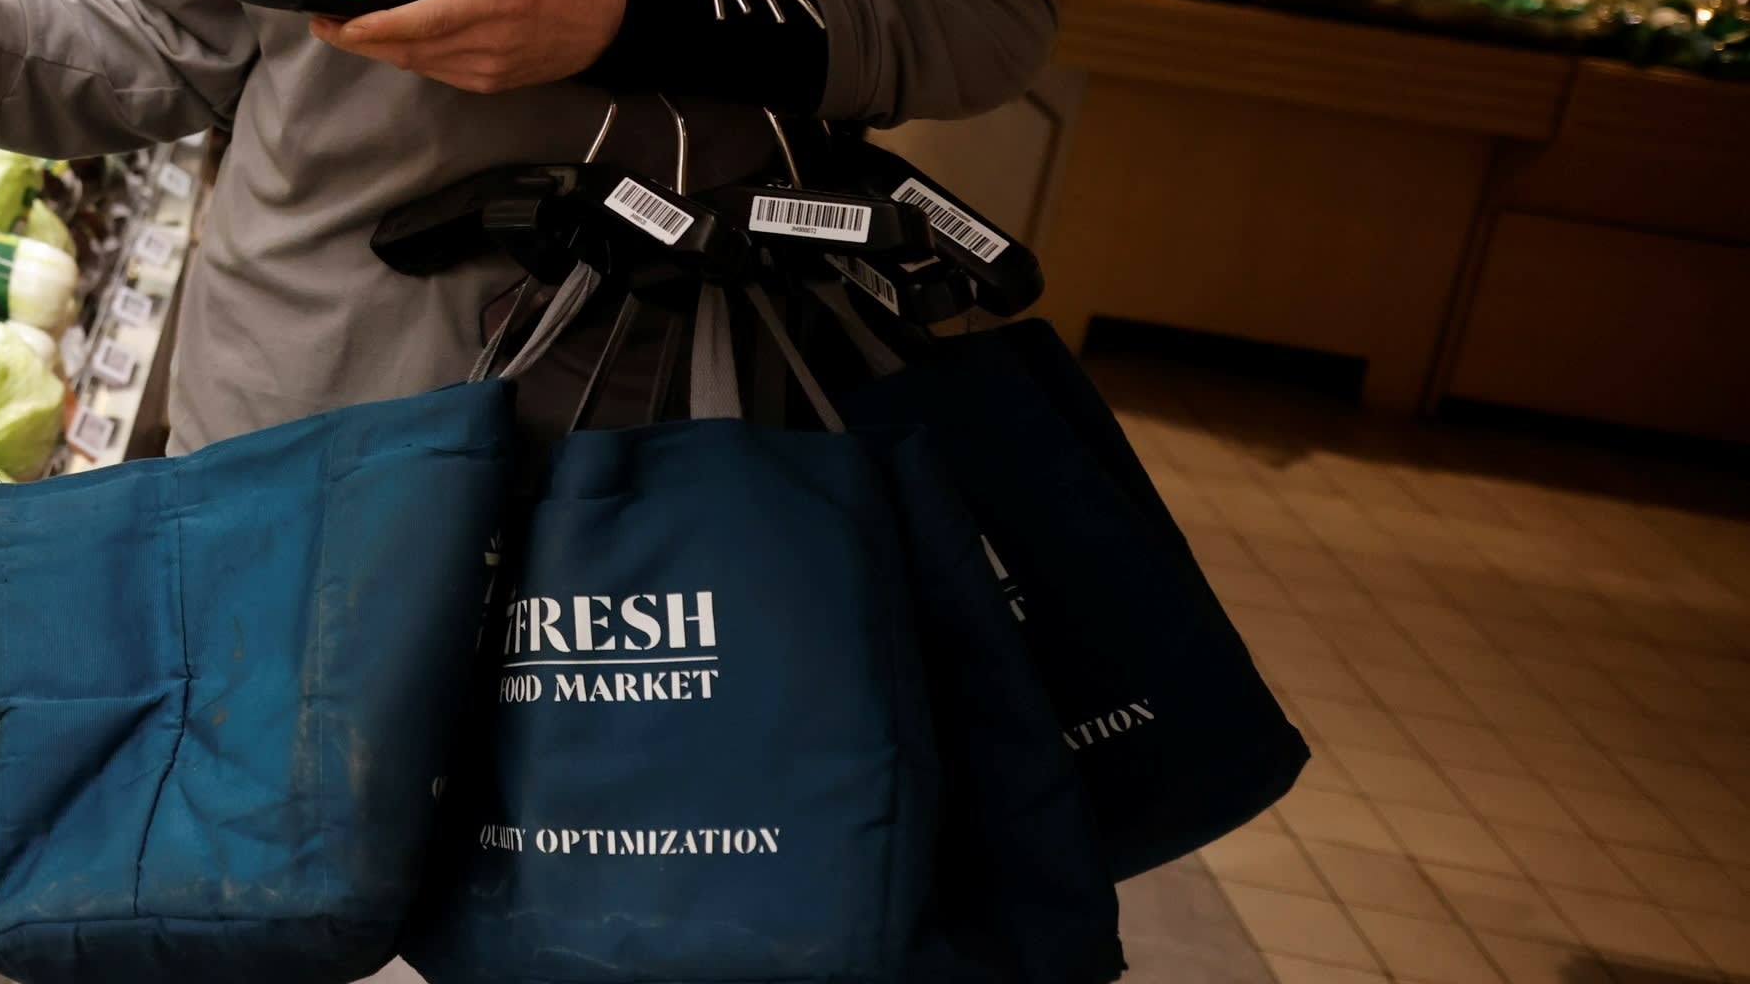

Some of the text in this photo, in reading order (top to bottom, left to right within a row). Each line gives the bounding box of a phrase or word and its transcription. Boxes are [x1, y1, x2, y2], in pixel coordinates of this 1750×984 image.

[499, 669, 719, 704] FOOD MARKET
[535, 827, 781, 856] OPTIMIZATION
